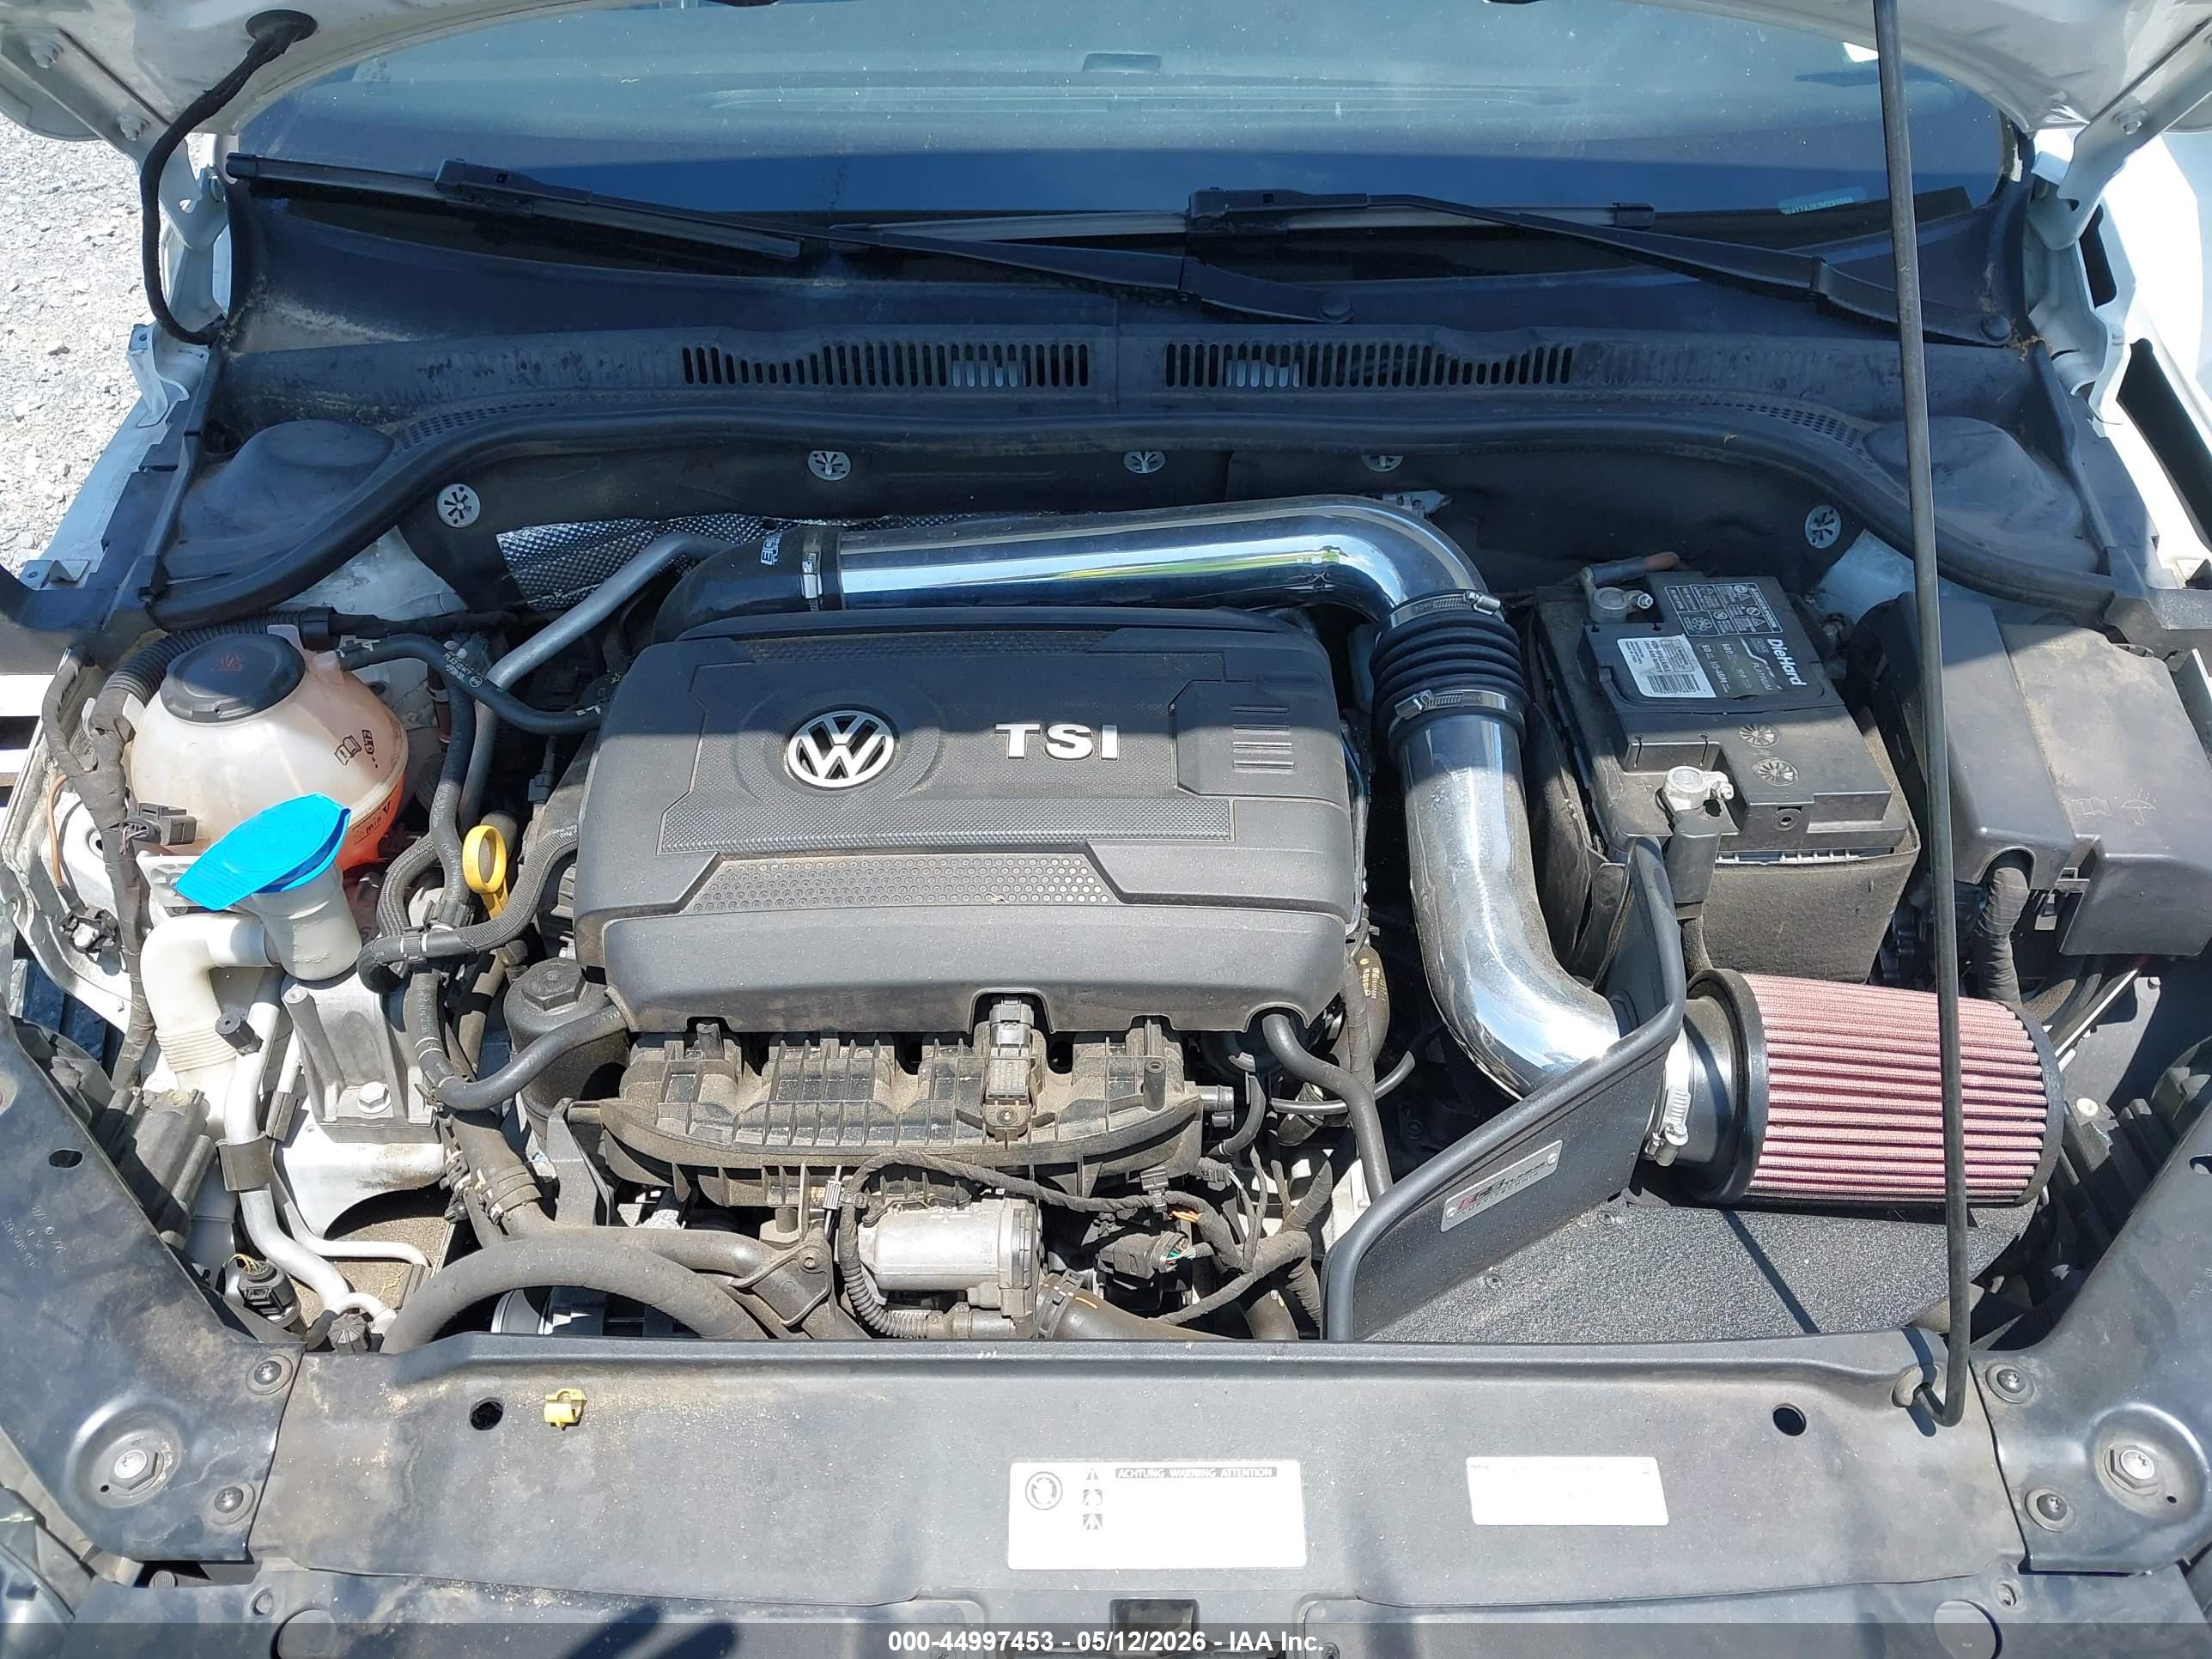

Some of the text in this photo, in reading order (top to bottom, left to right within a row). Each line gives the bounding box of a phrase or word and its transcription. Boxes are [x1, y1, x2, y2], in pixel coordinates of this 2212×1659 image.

[1752, 662, 1773, 691] PLATINUM
[1767, 638, 1808, 686] DieHard
[994, 723, 1119, 762] TSI
[366, 817, 382, 834] min
[1118, 1468, 1273, 1479] ACHTUNG WARNING ATTENTION
